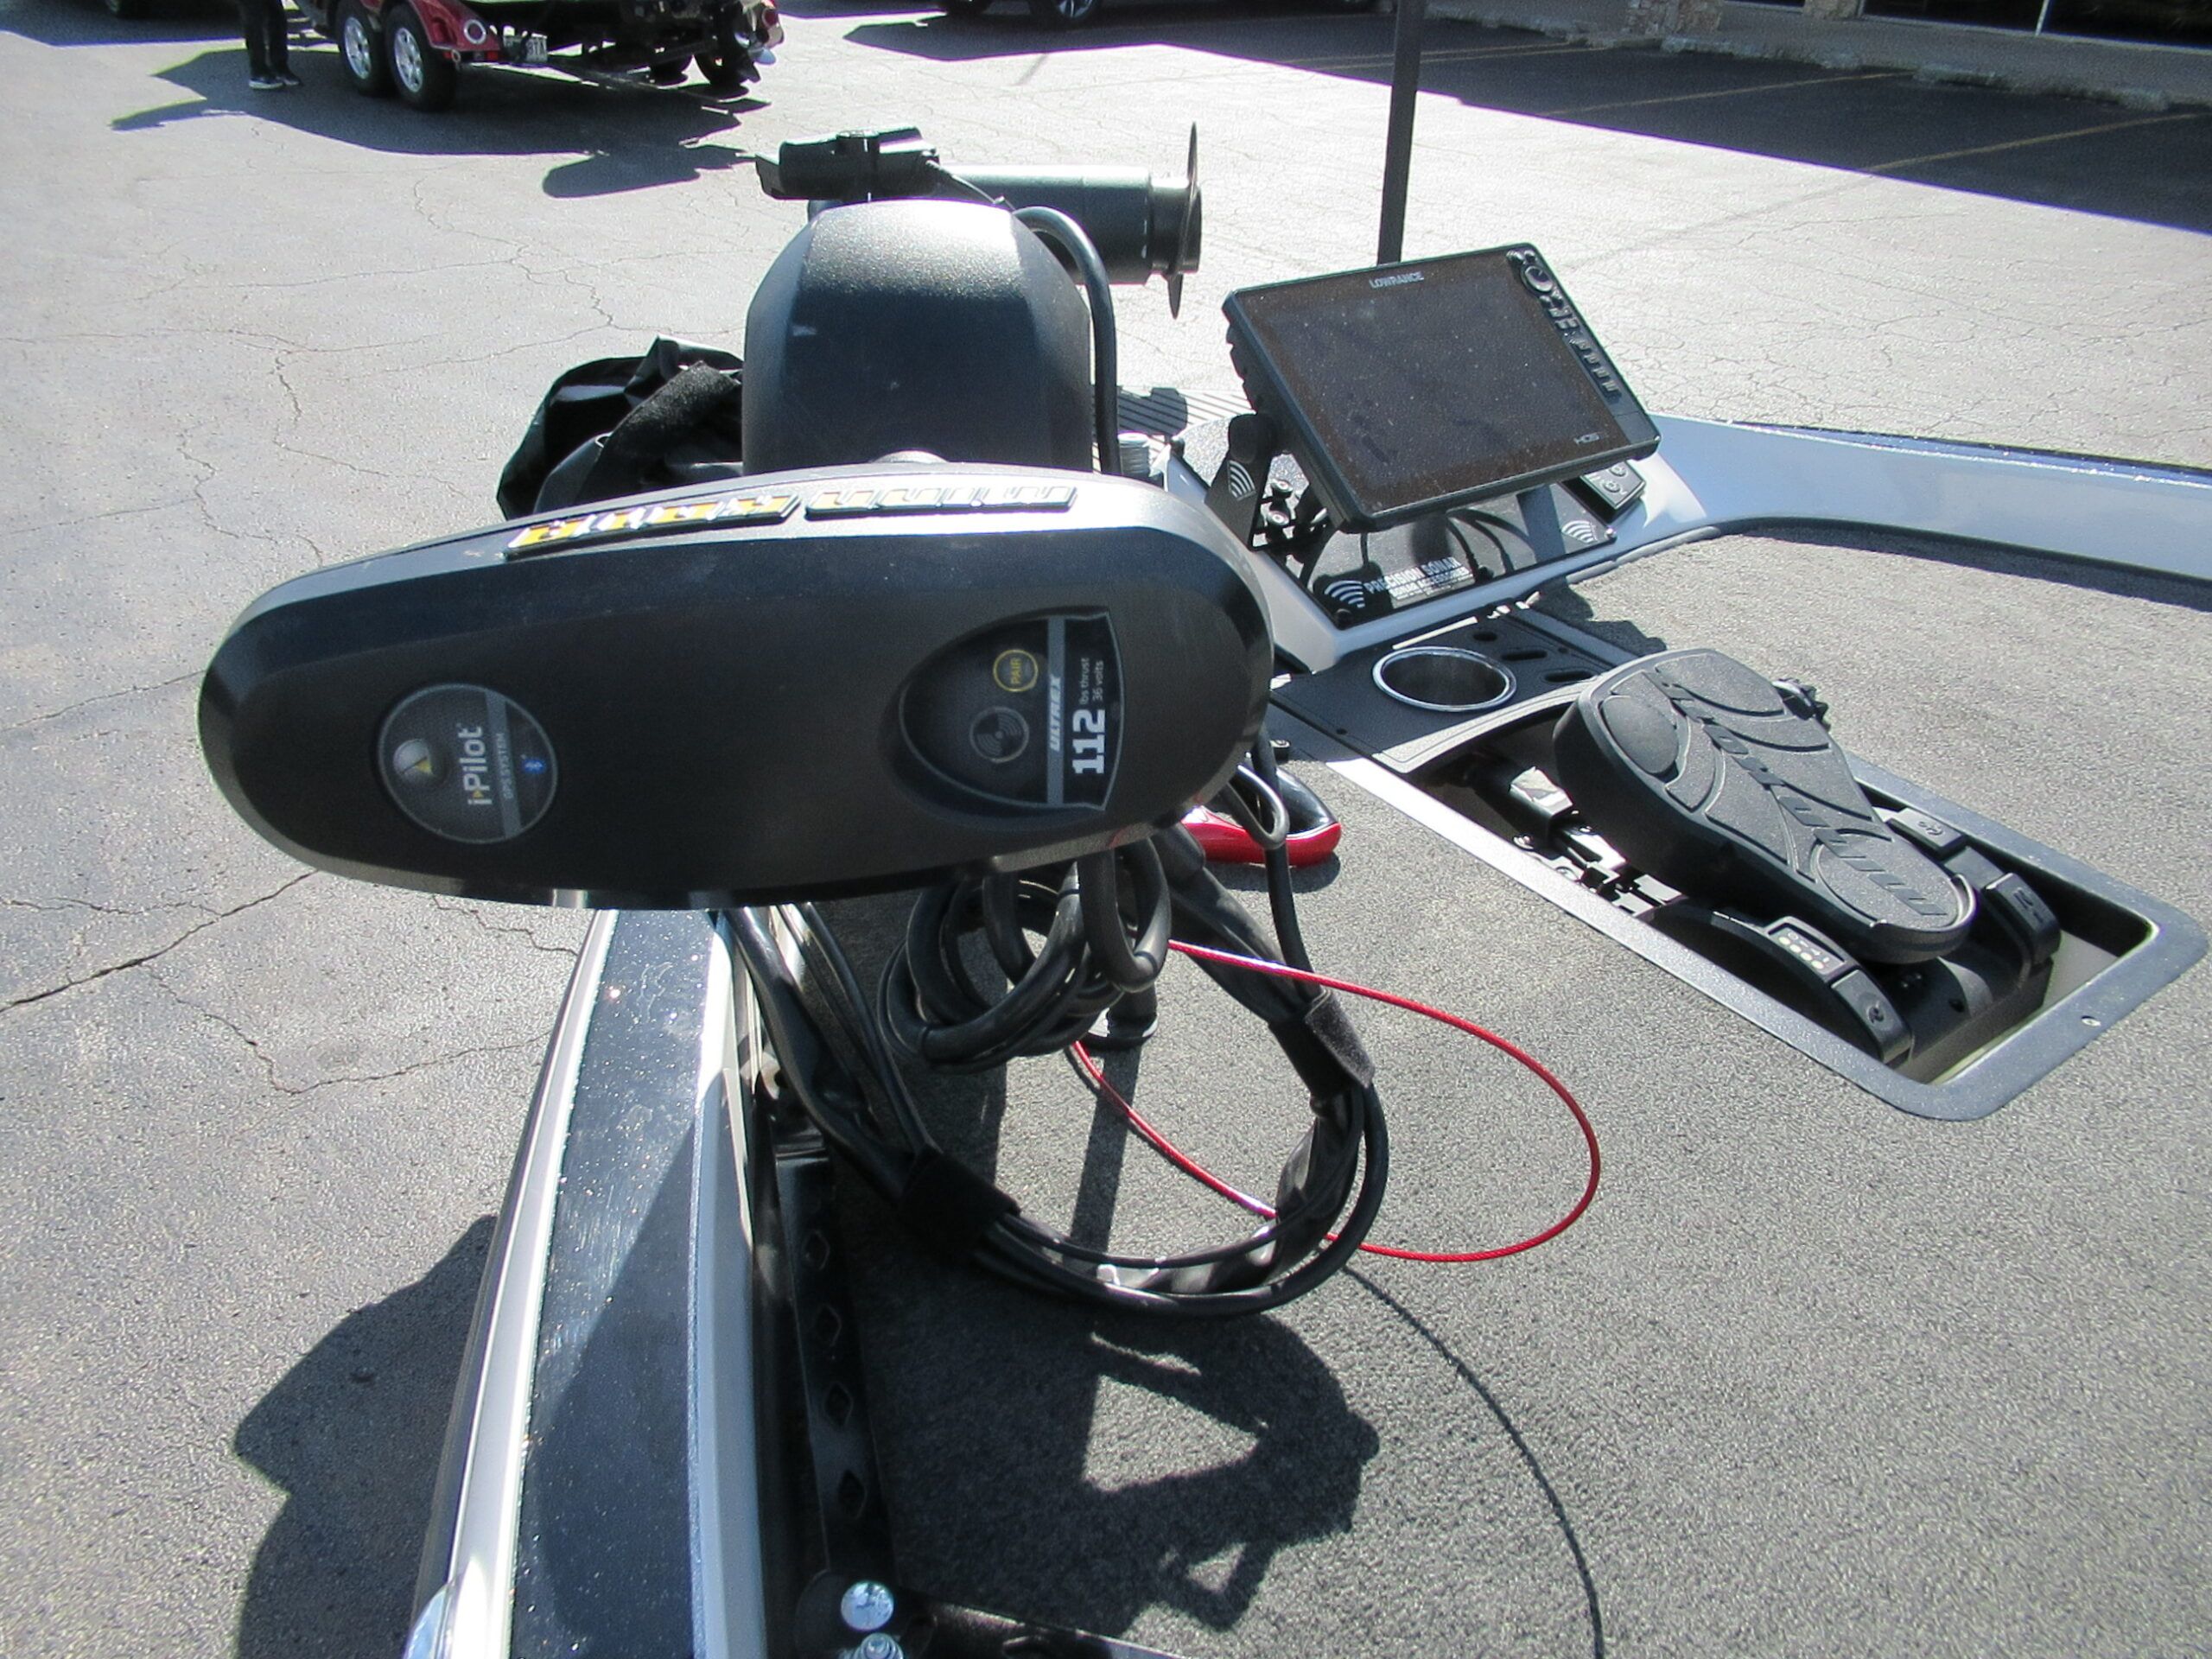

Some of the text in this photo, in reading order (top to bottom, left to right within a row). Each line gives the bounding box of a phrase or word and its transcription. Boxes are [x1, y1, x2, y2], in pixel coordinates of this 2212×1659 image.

[1369, 271, 1424, 289] LOWRANCE
[1363, 566, 1427, 594] PRECISION
[1421, 556, 1463, 576] SONAR
[1009, 657, 1023, 686] PAIR
[1078, 657, 1090, 705] lbs thrust
[1092, 659, 1104, 702] 36 volts
[1049, 673, 1062, 753] ULTREX
[1071, 709, 1106, 775] 112
